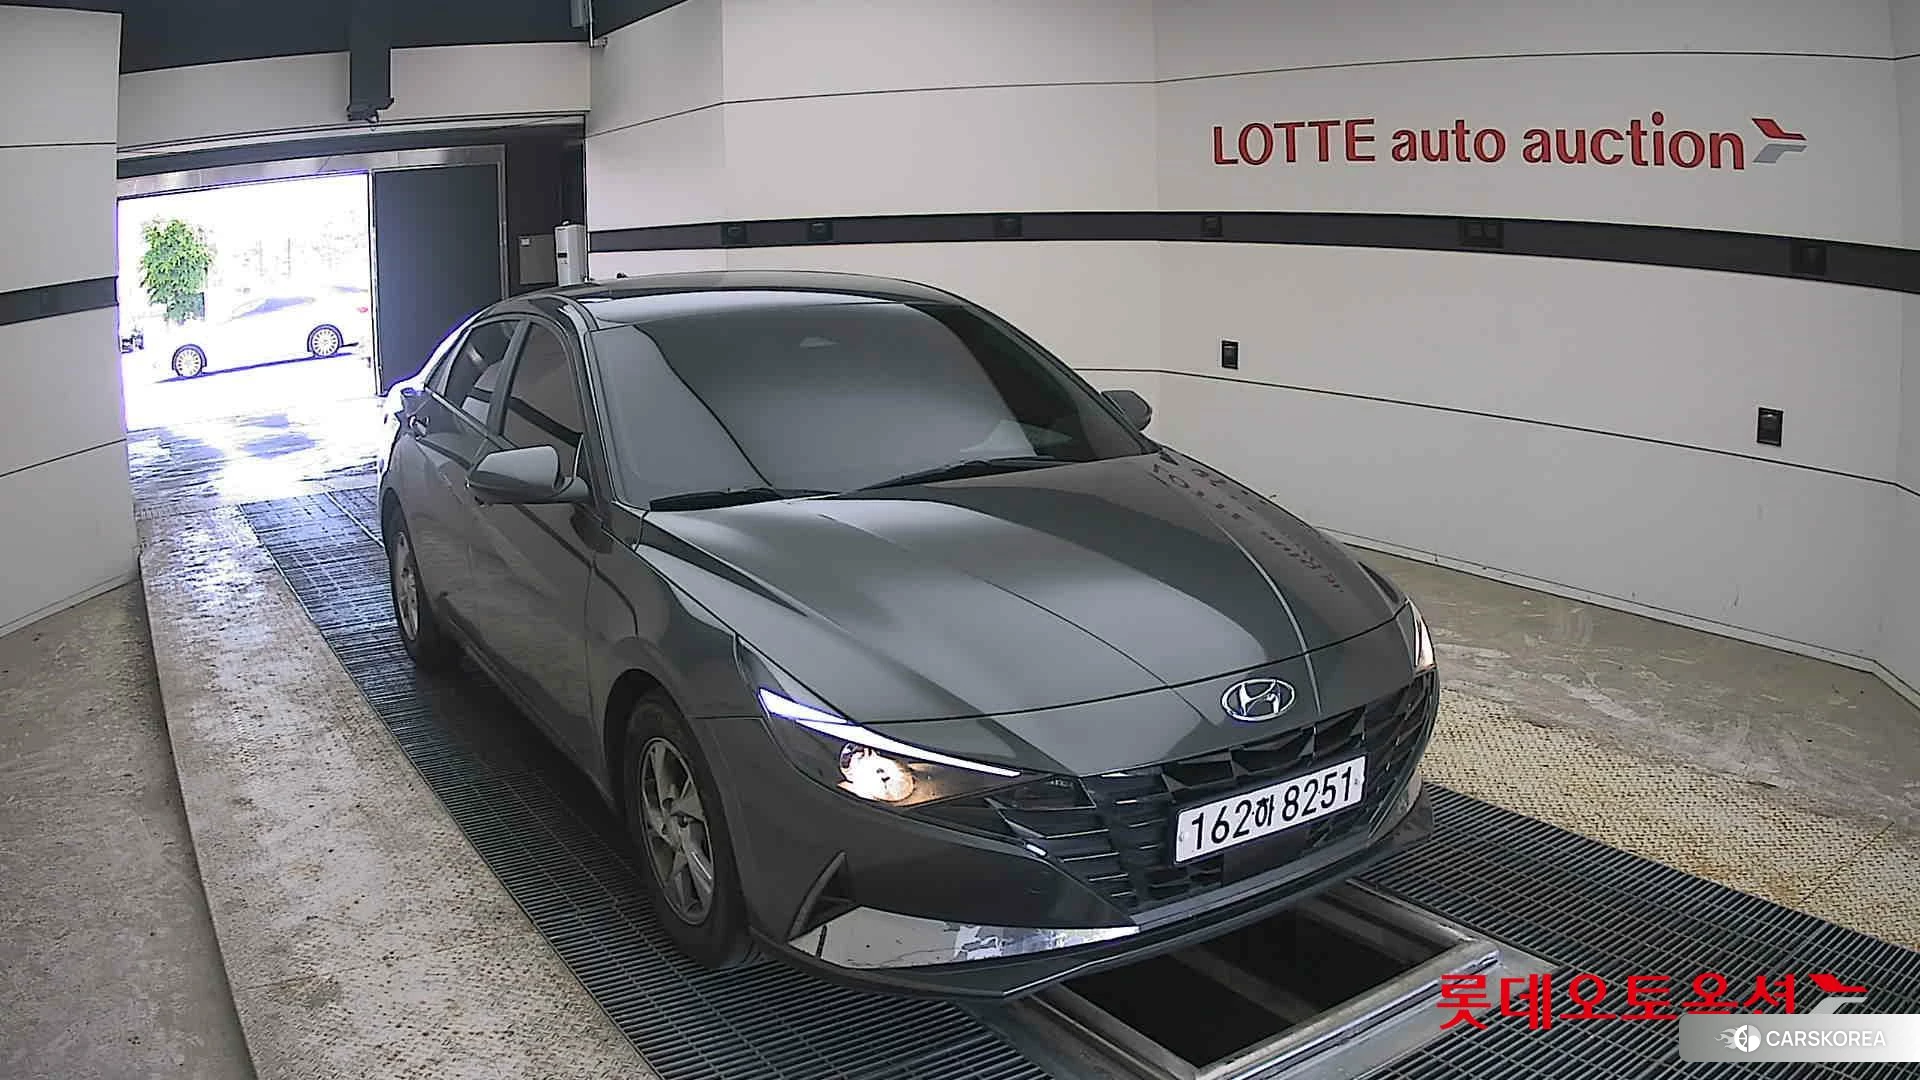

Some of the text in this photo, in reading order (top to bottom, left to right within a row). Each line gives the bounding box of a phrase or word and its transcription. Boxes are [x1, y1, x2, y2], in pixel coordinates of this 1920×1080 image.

[1212, 111, 1746, 170] LOTTE auto auction
[1191, 766, 1352, 850] 162하 8251
